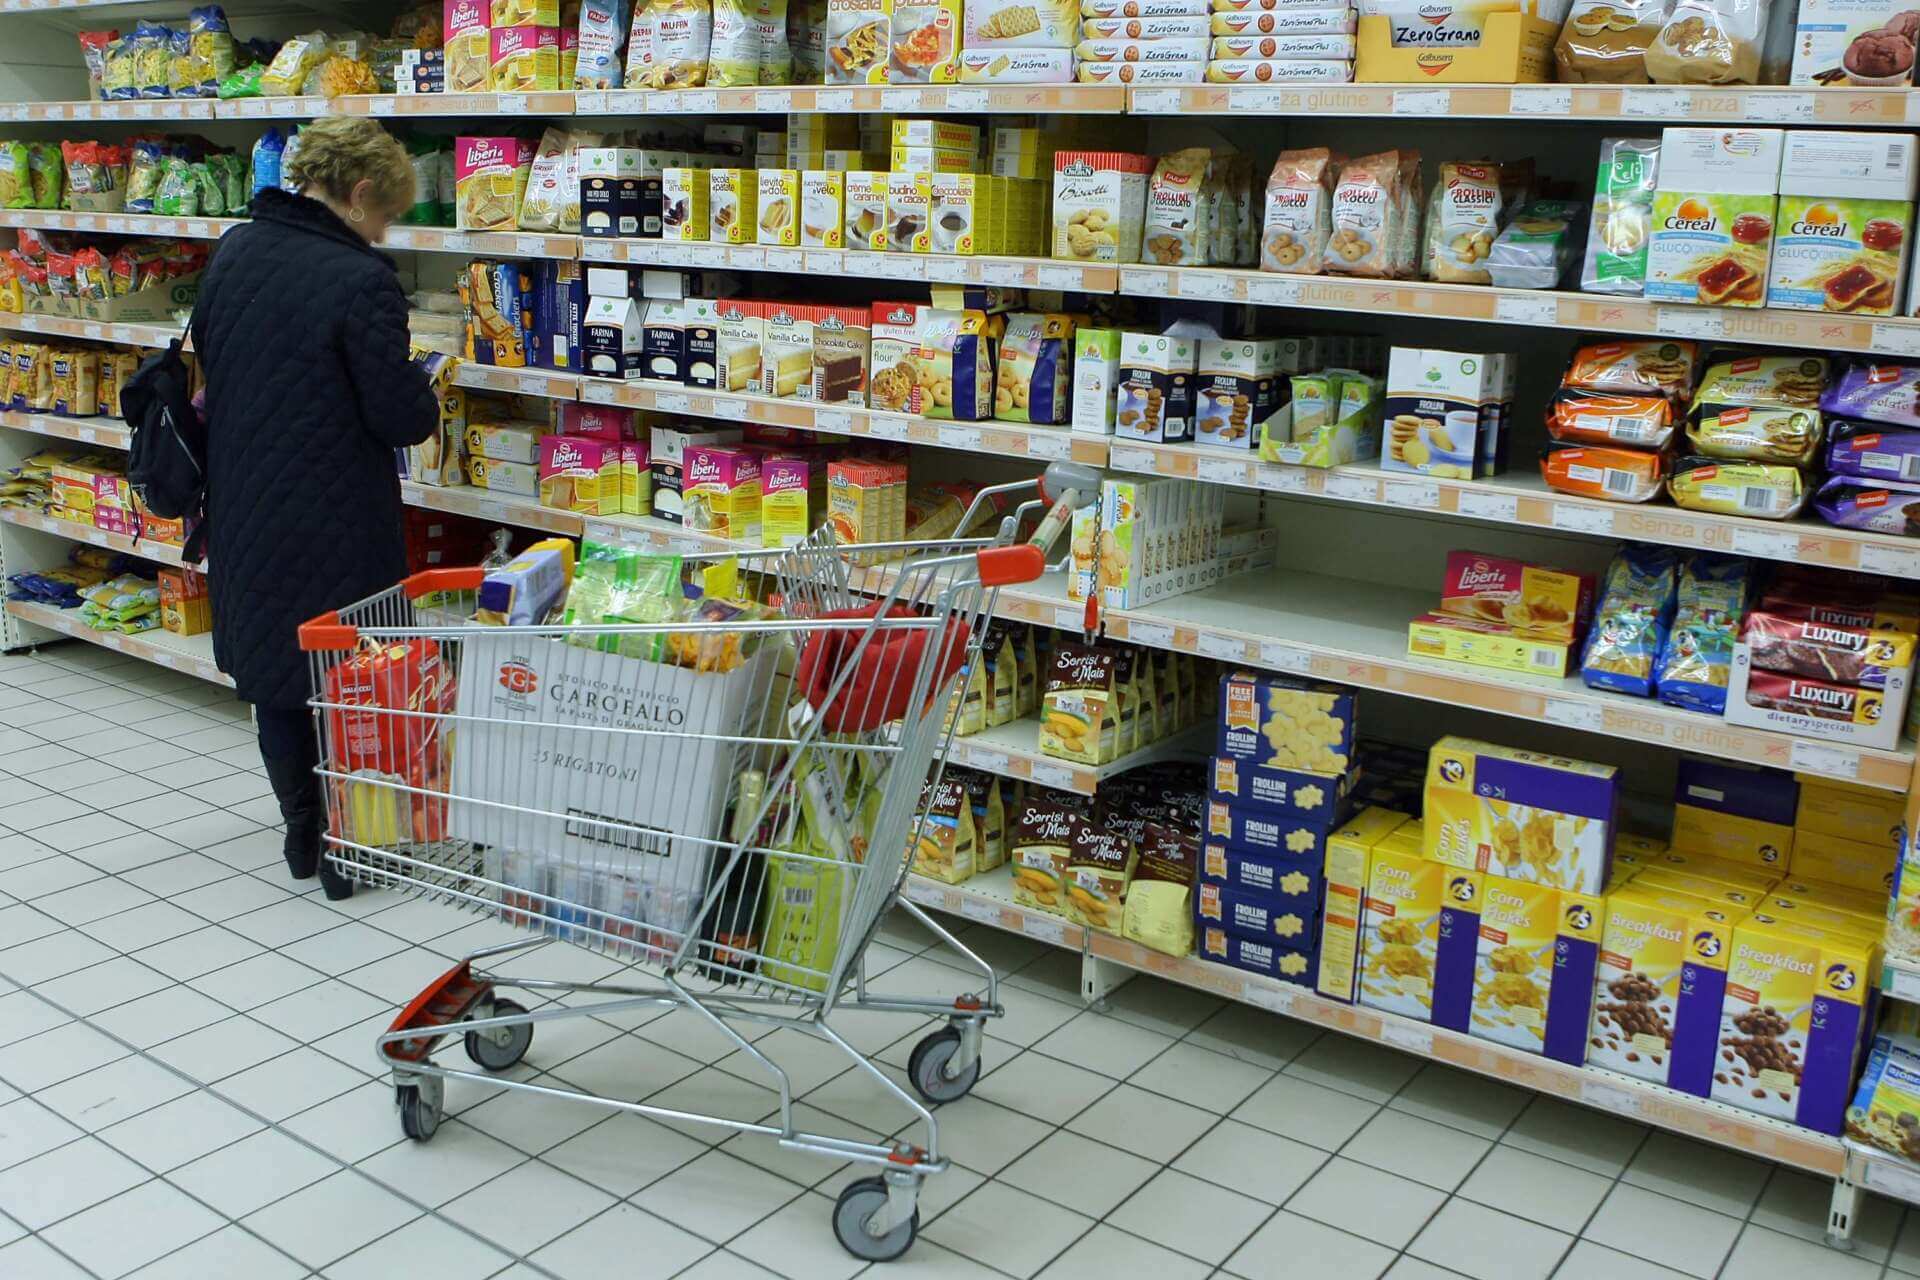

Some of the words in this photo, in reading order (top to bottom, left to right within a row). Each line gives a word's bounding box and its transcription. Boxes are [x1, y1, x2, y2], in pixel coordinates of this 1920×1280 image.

[1419, 4, 1452, 13] Galbusera
[451, 7, 475, 29] Liberi
[661, 20, 688, 30] MUFFIN
[1397, 26, 1480, 43] ZeroGrano
[1010, 60, 1050, 70] ZeroGrano
[1418, 53, 1453, 63] Galbusera
[1308, 90, 1369, 111] glutine
[466, 146, 498, 167] Liberi
[669, 184, 690, 192] amaro
[760, 174, 784, 186] lievito
[847, 184, 871, 193] crème
[768, 185, 788, 196] dolci
[817, 186, 835, 195] velo
[853, 191, 885, 202] caramel
[889, 186, 917, 195] budino
[1154, 191, 1189, 201] FROLLINI
[1451, 189, 1495, 199] FROLLINI
[904, 195, 928, 204] cacao
[947, 197, 967, 206] tazza
[1453, 195, 1494, 204] CLASSICI
[1665, 214, 1717, 232] Céréal
[1791, 221, 1847, 237] Céréal
[1297, 284, 1355, 305] glutine
[591, 328, 614, 338] FARINA
[1721, 312, 1797, 337] glutine
[651, 330, 675, 340] FARINA
[720, 328, 741, 338] Vanilla
[741, 330, 758, 339] Cake
[768, 332, 790, 343] Vanilla
[791, 334, 810, 344] Cake
[815, 337, 846, 348] Chocolate
[847, 341, 864, 350] Cake
[874, 350, 893, 363] flour
[552, 449, 577, 468] Liberi
[690, 461, 716, 480] Liberi
[768, 473, 796, 489] Liberi
[1629, 515, 1694, 538] Senza
[1458, 566, 1500, 589] Liberi
[1801, 622, 1866, 650] Luxury
[1058, 651, 1097, 669] Sorrisi
[1080, 665, 1105, 680] Mais
[1789, 681, 1854, 710] Luxury
[550, 684, 684, 726] GAROFALO
[1226, 732, 1257, 745] FROLLINI
[1603, 710, 1665, 736] Senza
[1671, 717, 1745, 751] glutine
[552, 752, 639, 782] RIGATONI
[1253, 776, 1286, 793] FROLLINI
[1023, 808, 1064, 825] Sorrisi
[1105, 813, 1145, 831] Sorrisi
[1045, 821, 1070, 837] Mais
[1246, 819, 1278, 835] FROLLINI
[1077, 828, 1116, 846] Sorrisi
[1435, 821, 1450, 861] Corn
[1452, 817, 1473, 864] Flakes
[1098, 844, 1122, 861] Mais
[1240, 862, 1273, 877] FROLLINI
[1375, 861, 1410, 882] Corn
[1375, 880, 1417, 901] Flakes
[1487, 887, 1525, 910] Corn
[1235, 903, 1267, 918] FROLLINI
[1486, 906, 1532, 930] Flakes
[1611, 912, 1682, 944] Breakfast
[1240, 940, 1273, 956] FROLLINI
[1608, 931, 1645, 953] Pops
[1738, 943, 1816, 977] Breakfast
[1735, 961, 1774, 985] Pops
